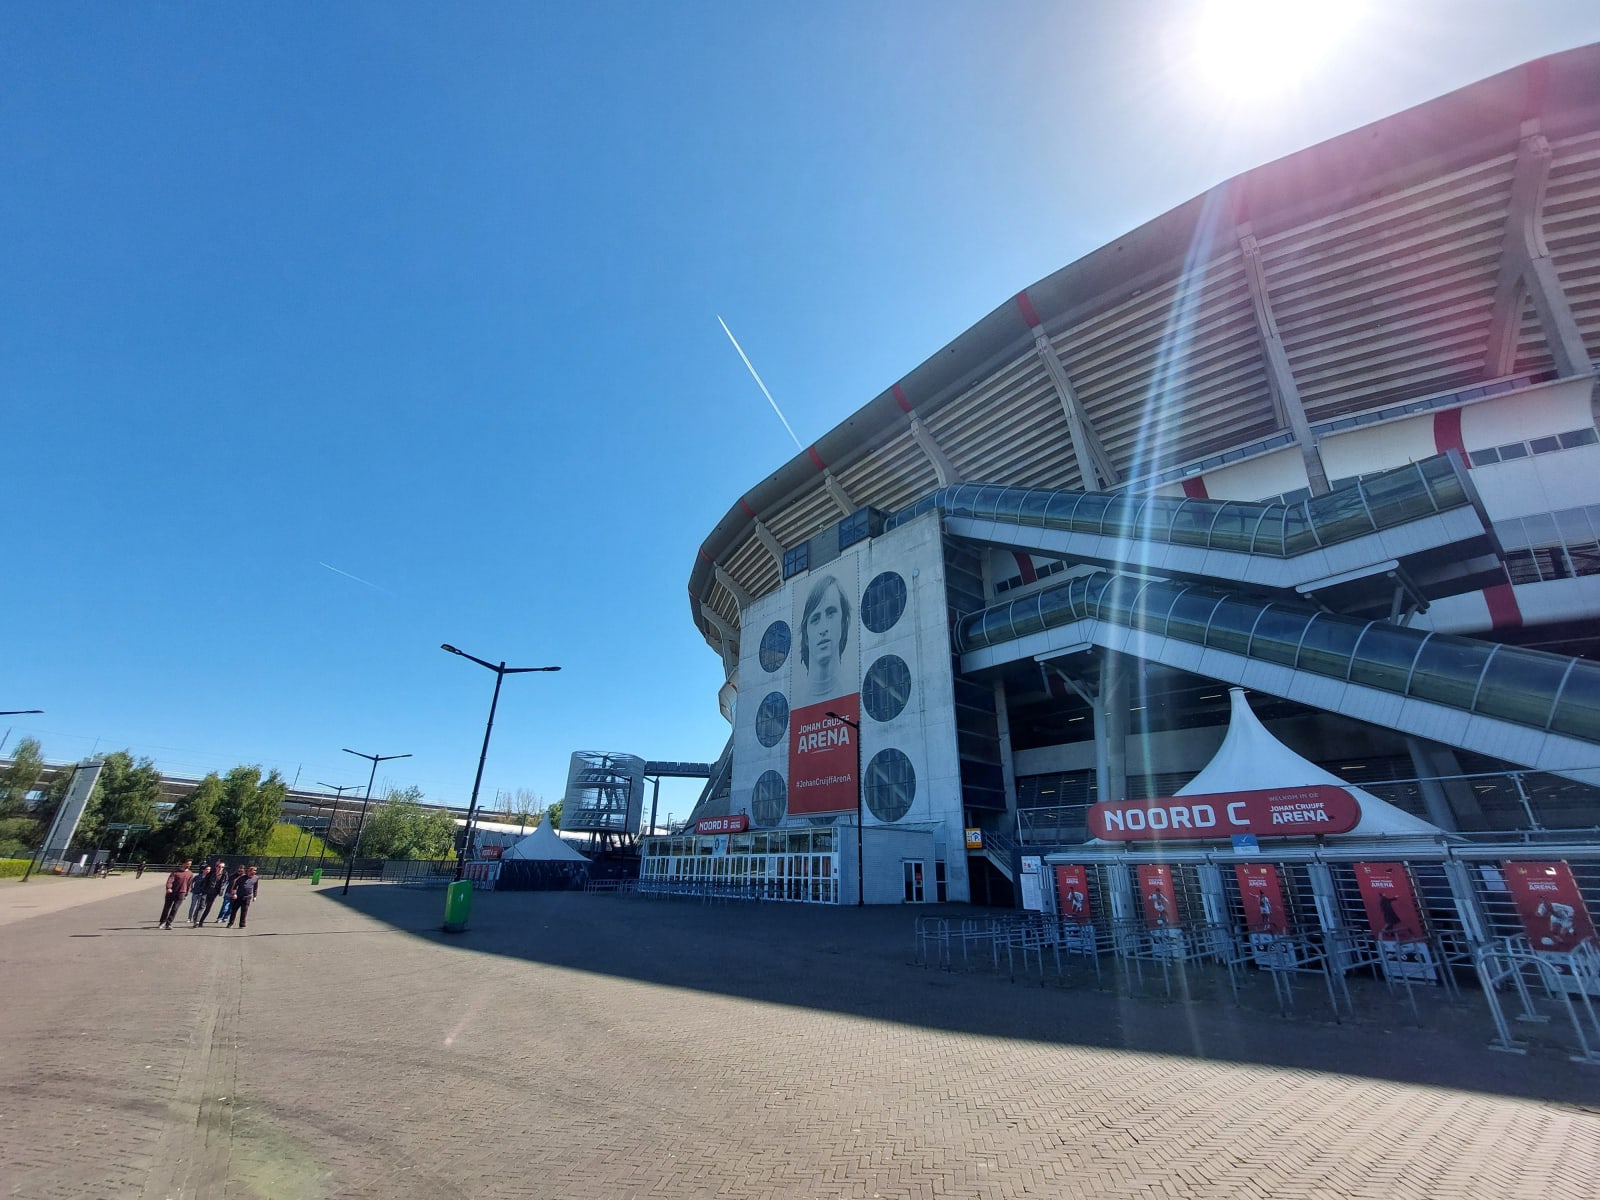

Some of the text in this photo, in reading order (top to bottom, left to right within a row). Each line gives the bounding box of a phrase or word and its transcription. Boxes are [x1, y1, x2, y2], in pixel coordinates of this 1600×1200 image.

[798, 722, 820, 734] JOHAN
[797, 726, 850, 754] ARENA
[1269, 804, 1295, 812] JOHAN
[1103, 801, 1251, 831] NOORD C
[1272, 809, 1329, 825] ARENA
[698, 820, 722, 831] NOORD
[723, 819, 729, 829] B
